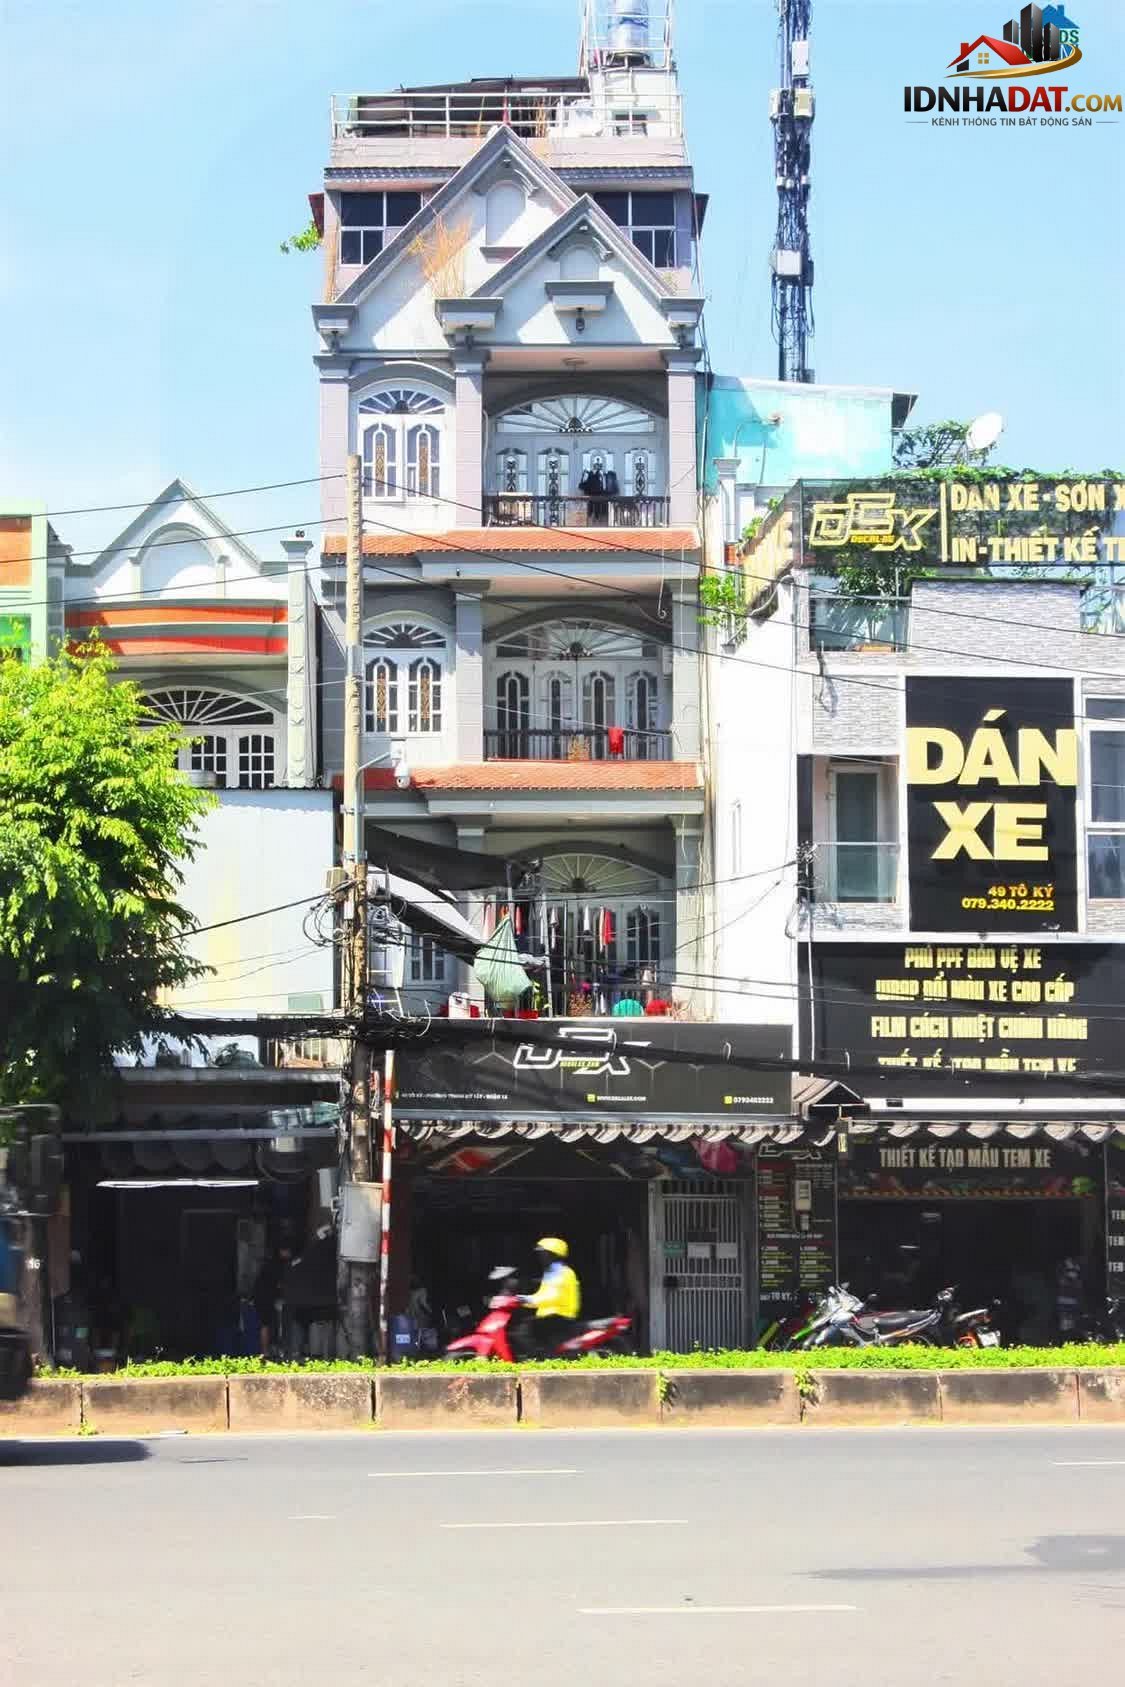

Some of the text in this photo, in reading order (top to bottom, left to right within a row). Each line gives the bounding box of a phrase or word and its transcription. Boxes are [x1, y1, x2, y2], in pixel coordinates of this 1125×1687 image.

[1063, 525, 1100, 562] KẾ
[905, 709, 1078, 786] DÁN
[930, 802, 1048, 861] XE
[988, 886, 1006, 897] 49
[1033, 883, 1054, 897] KÝ
[961, 897, 1054, 911] 079.340.2222
[1023, 947, 1041, 969] XE
[988, 981, 1007, 1001] XE
[880, 1143, 916, 1167] THIẾT
[1002, 1148, 1031, 1168] TEM
[1034, 1148, 1051, 1168] XE
